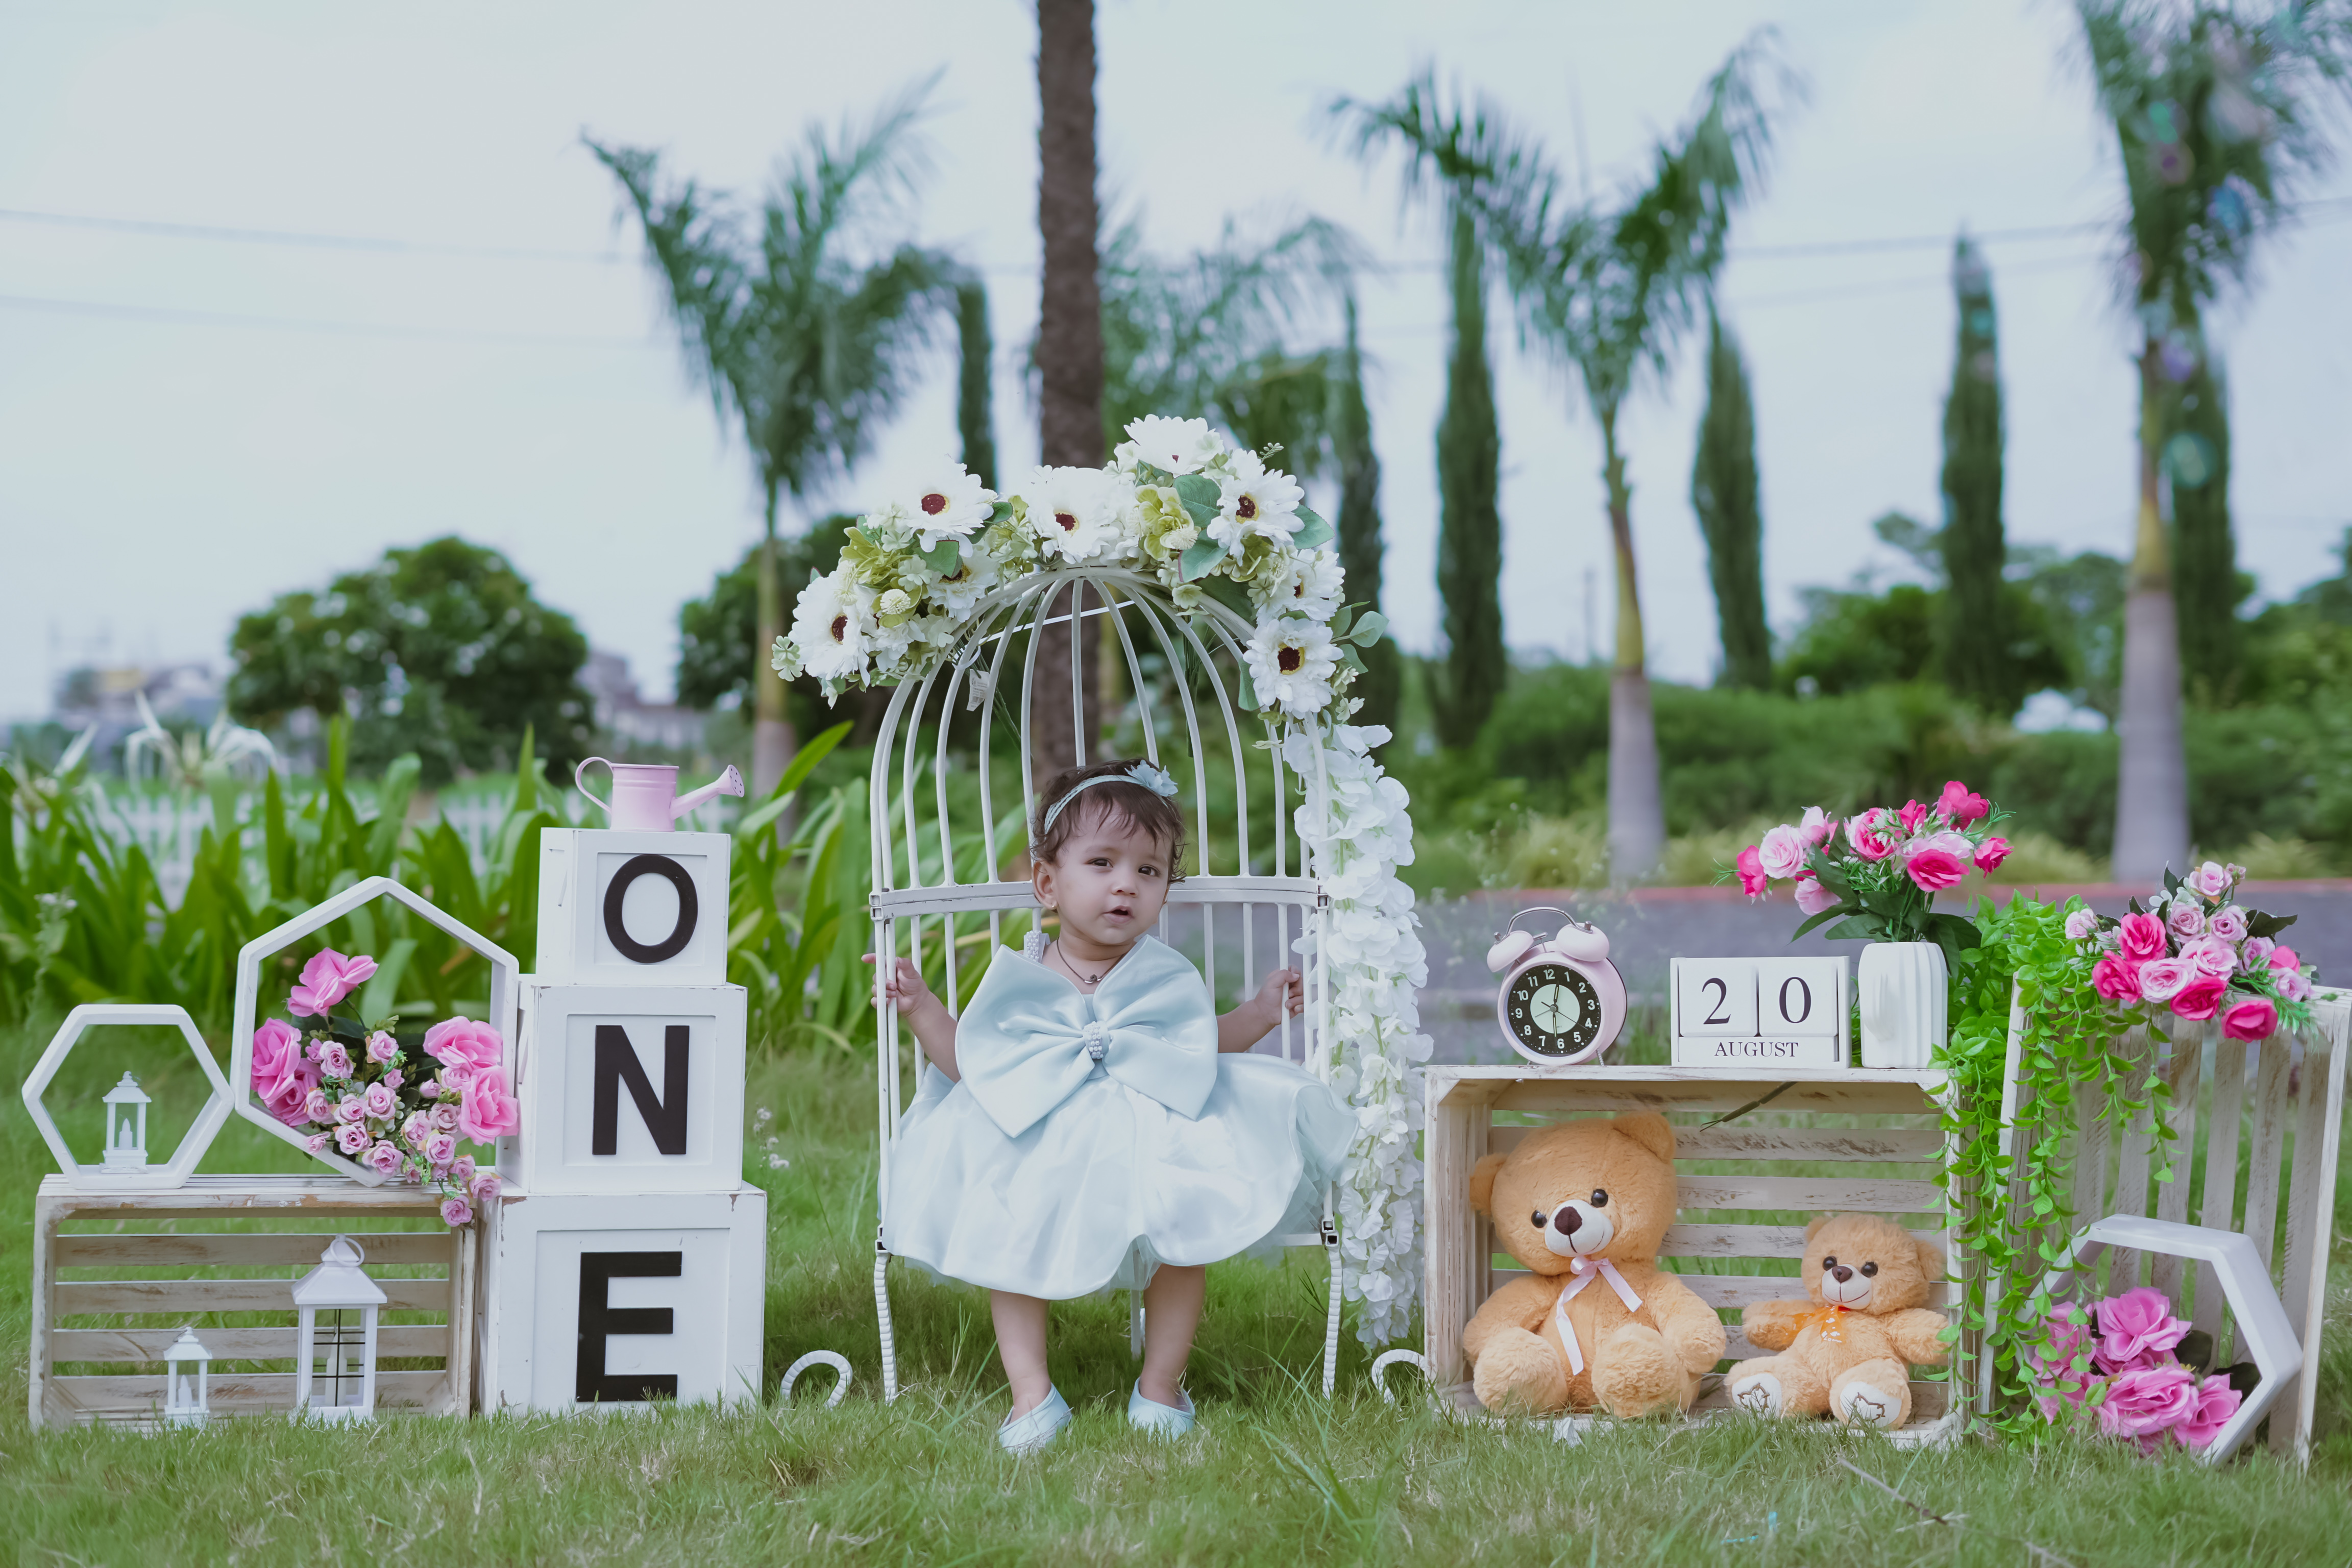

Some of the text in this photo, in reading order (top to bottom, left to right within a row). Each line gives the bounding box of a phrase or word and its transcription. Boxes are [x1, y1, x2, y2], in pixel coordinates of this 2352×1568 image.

[1543, 969, 1556, 980] 12
[1564, 971, 1570, 982] 1
[1527, 975, 1538, 987] 11
[1578, 982, 1587, 993] 2
[1516, 990, 1529, 1001] 10
[1587, 999, 1596, 1010] 3
[1515, 1008, 1523, 1019] 9
[1585, 1017, 1592, 1028] 4
[1524, 1024, 1532, 1036] 8
[1538, 1035, 1546, 1047] 7
[1573, 1031, 1581, 1043] 5
[1557, 1038, 1565, 1049] 6
[1714, 1041, 1799, 1057] AUGUST
